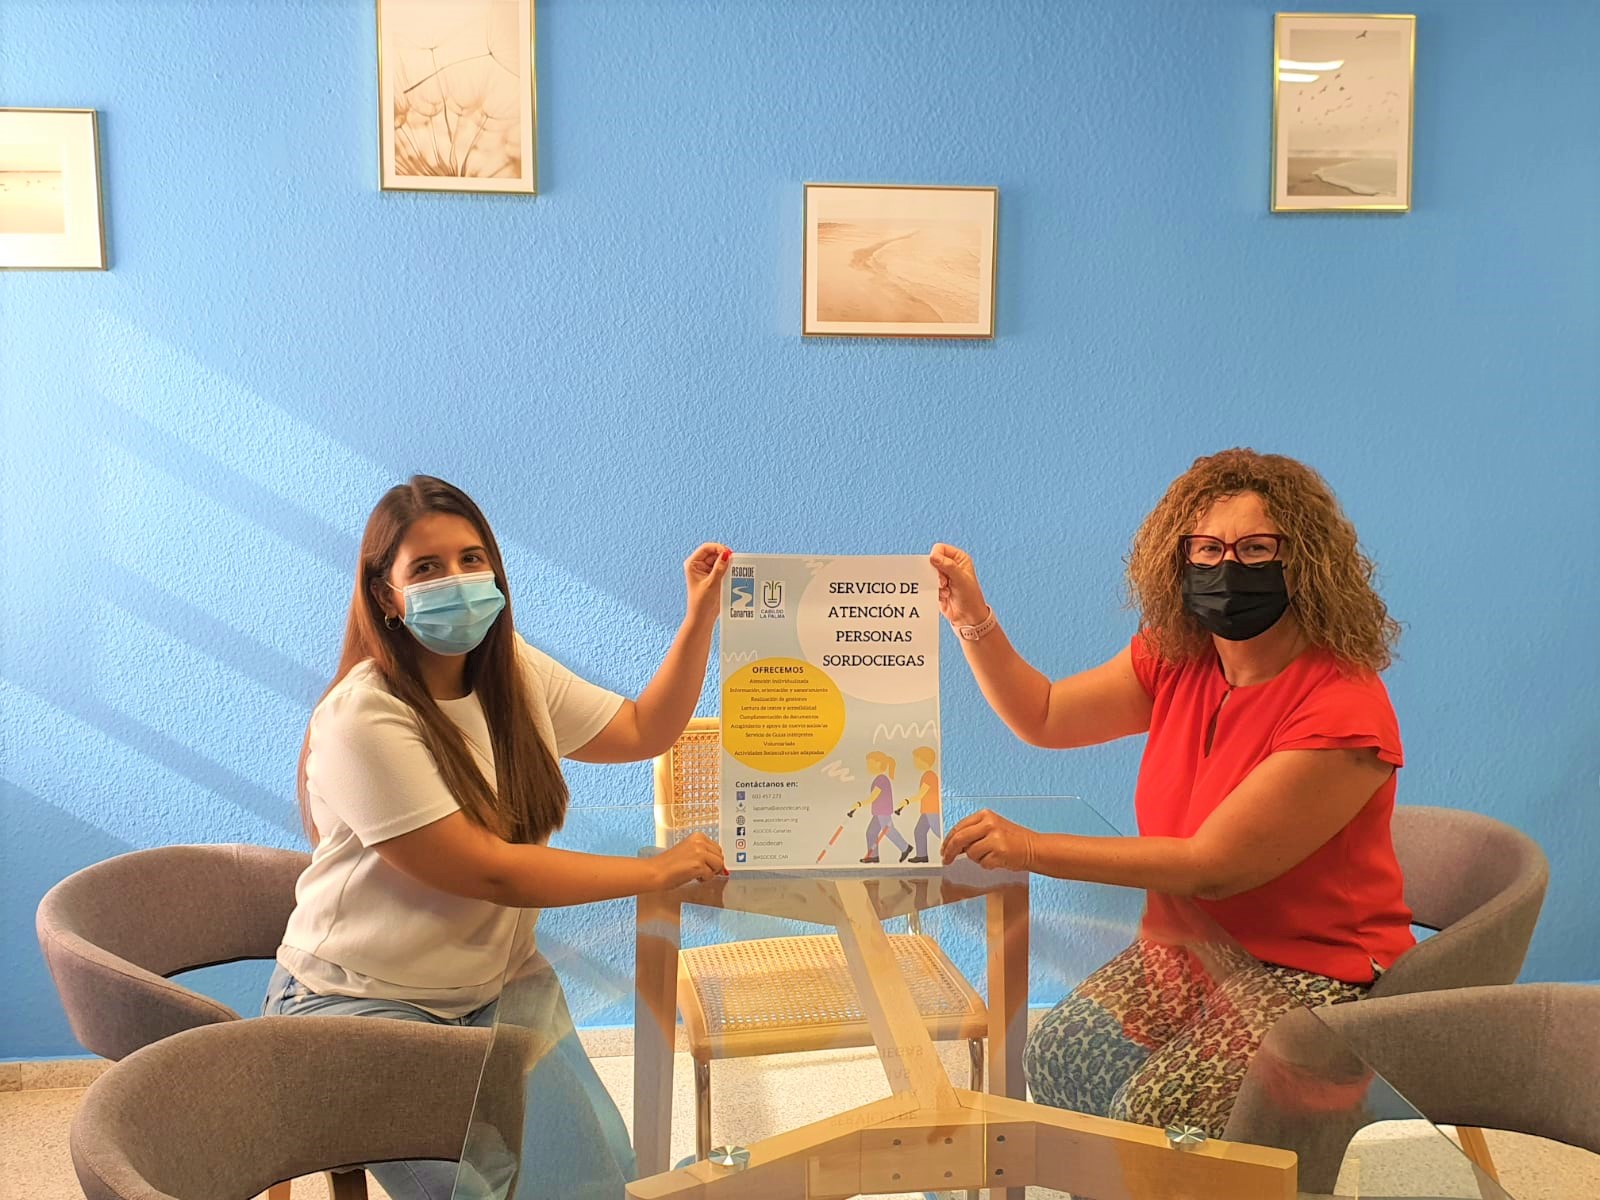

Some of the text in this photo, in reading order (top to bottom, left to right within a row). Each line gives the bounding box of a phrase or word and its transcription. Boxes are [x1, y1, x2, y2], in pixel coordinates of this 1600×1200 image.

[731, 566, 754, 578] ASOCIDE
[829, 582, 919, 594] SERVICIO DE
[730, 607, 754, 618] Canarias
[828, 604, 920, 618] ATENCIÓN A
[836, 630, 912, 643] PERSONAS
[823, 655, 925, 667] SORDOCIEGAS
[752, 666, 804, 674] OFRECEMOS
